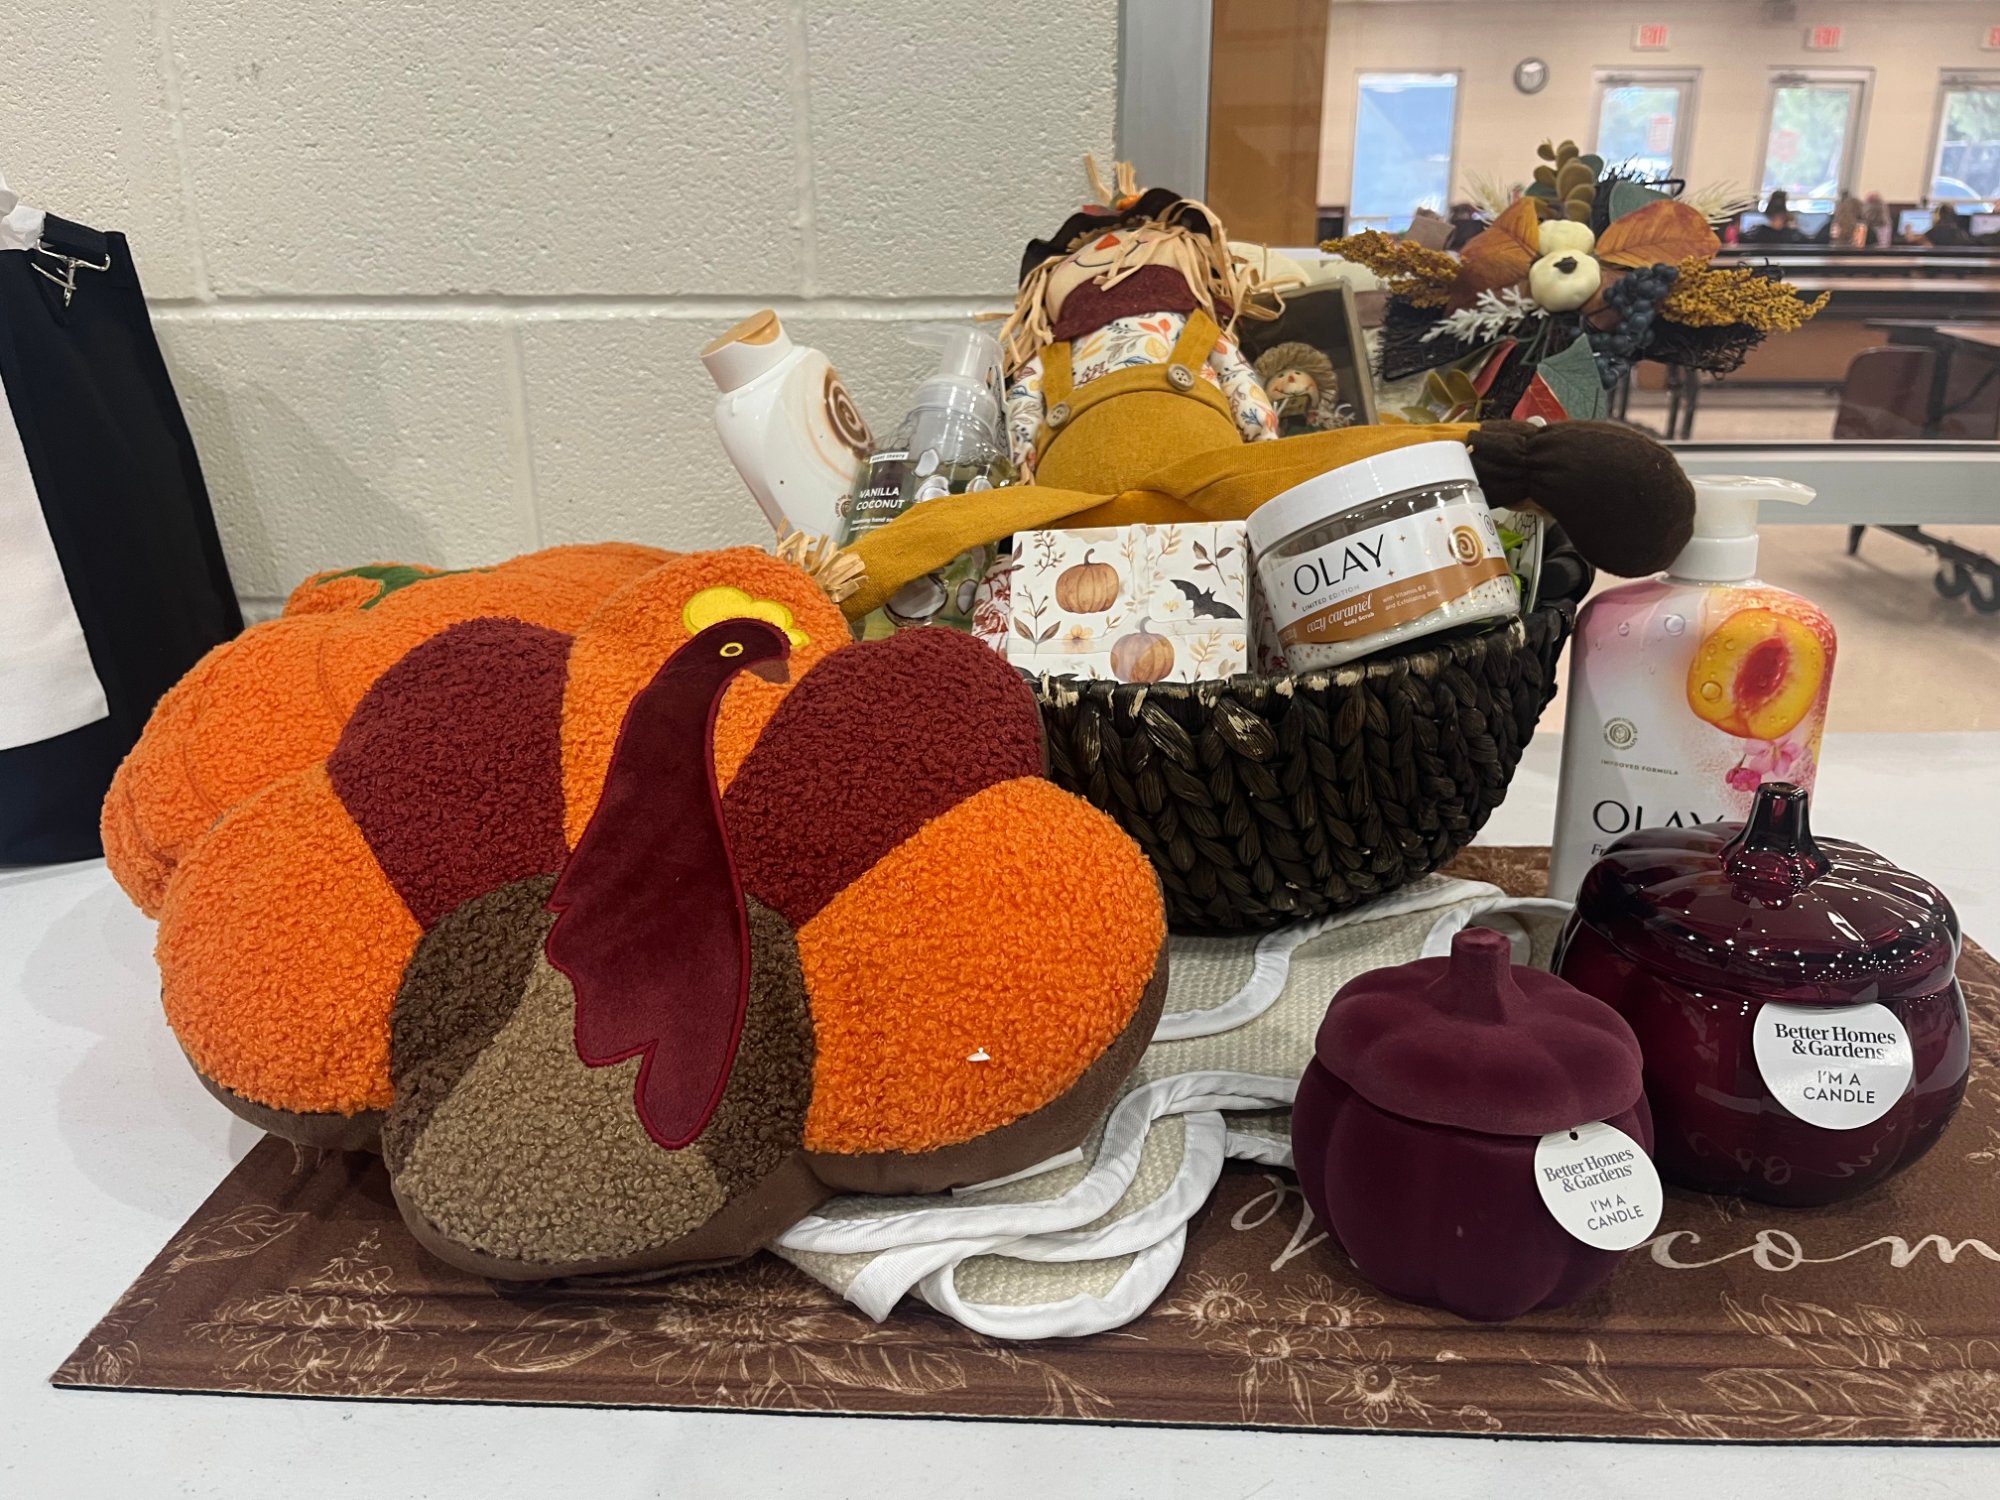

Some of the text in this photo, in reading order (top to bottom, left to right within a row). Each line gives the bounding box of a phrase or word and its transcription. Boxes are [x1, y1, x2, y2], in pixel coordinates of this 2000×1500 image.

[859, 486, 900, 498] VANILLA
[856, 499, 906, 511] COCONUT
[1294, 533, 1384, 595] OLAY
[1302, 584, 1360, 612] LIMITED EDITION
[1306, 592, 1373, 633] cozy caramel
[1601, 759, 1679, 776] IMPROVED FORMULA
[1774, 1023, 1897, 1045] Better Homes
[1818, 1070, 1861, 1086] I'M A
[1803, 1086, 1875, 1104] CANDLE
[1543, 1149, 1634, 1182] Better Homes
[1590, 1193, 1626, 1213] I'M A
[1587, 1205, 1644, 1231] CANDLE
